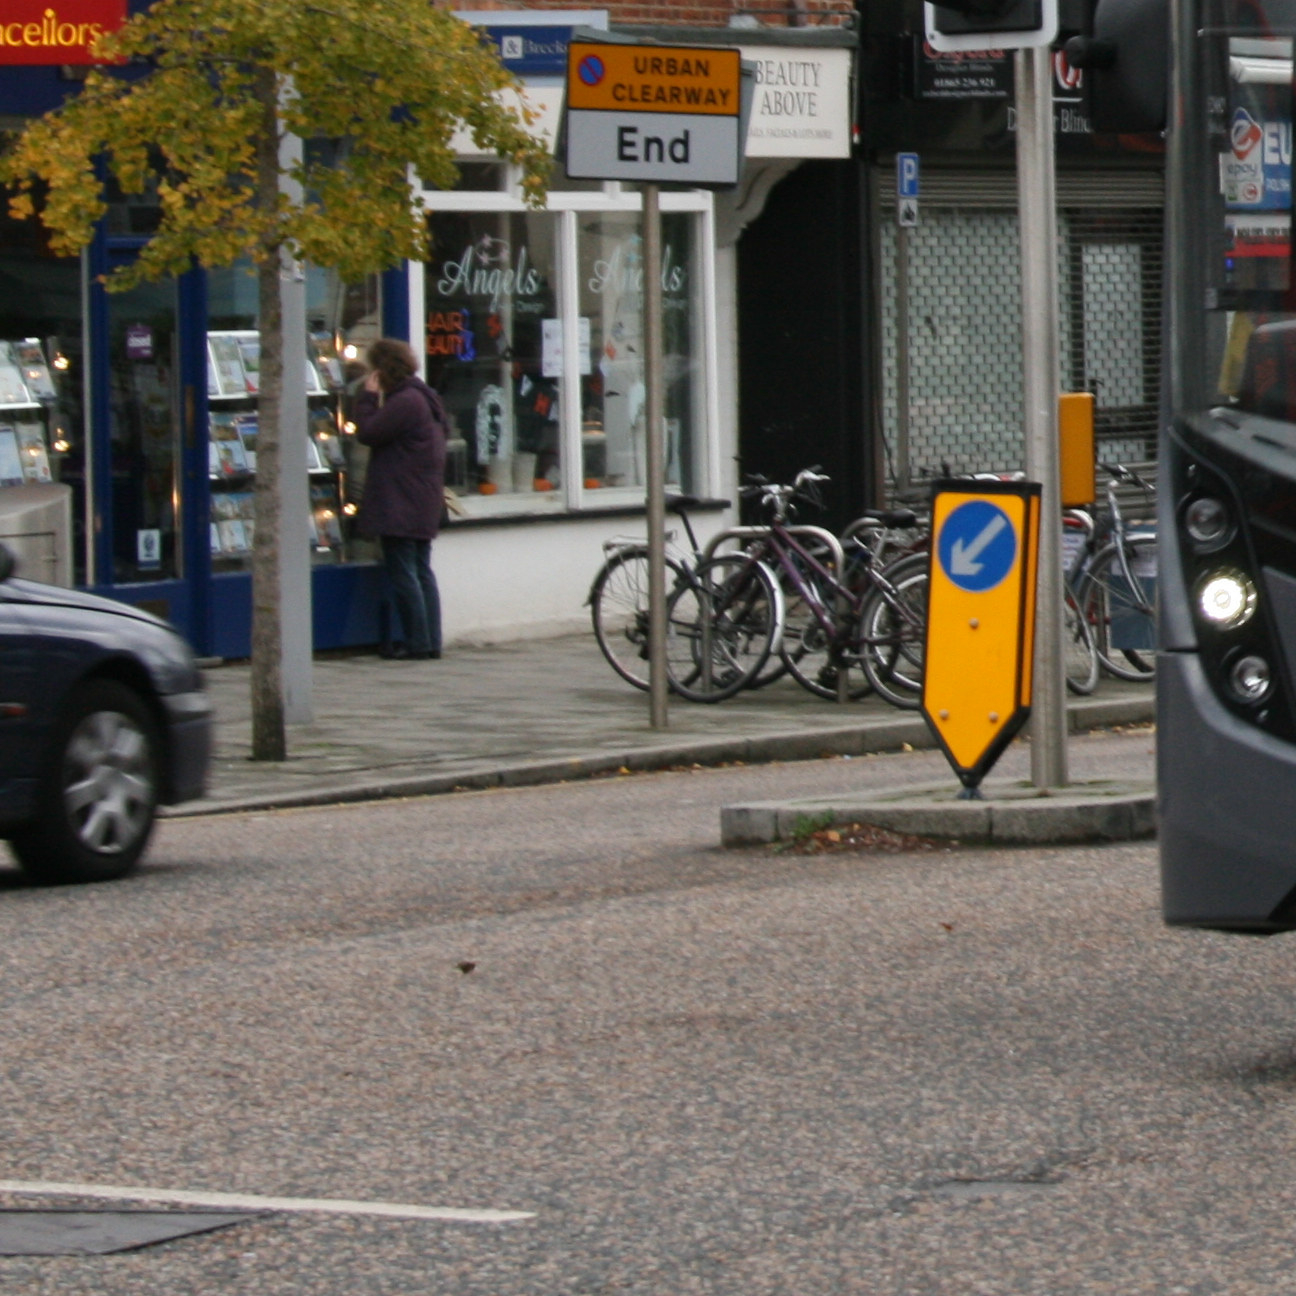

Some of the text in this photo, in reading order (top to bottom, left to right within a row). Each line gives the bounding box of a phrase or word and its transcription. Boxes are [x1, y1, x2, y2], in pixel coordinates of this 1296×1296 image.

[505, 38, 520, 55] &
[634, 56, 710, 77] URBAN
[755, 60, 821, 87] BEAUTY
[612, 83, 731, 105] CLEARWAY
[760, 90, 817, 117] ABOVE
[617, 126, 690, 164] End
[902, 158, 916, 194] P
[437, 245, 541, 315] Angels
[589, 245, 687, 293] Anls
